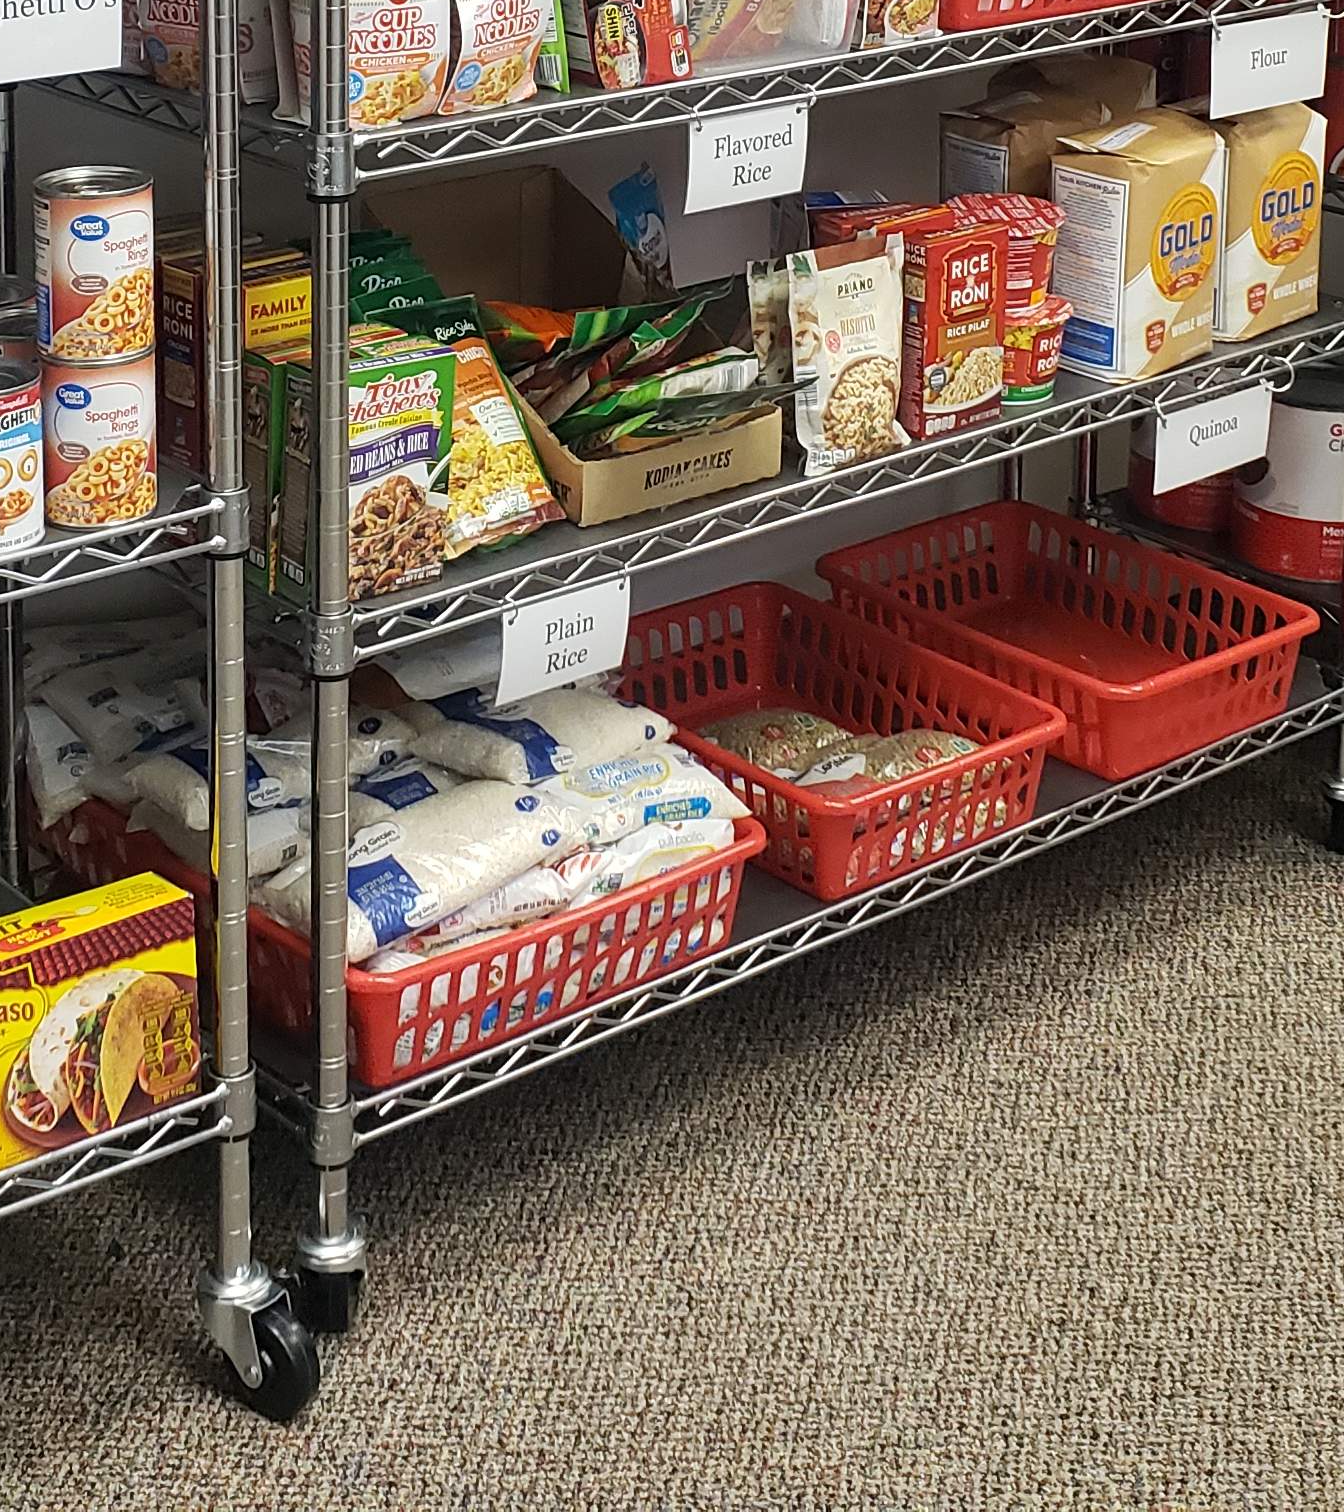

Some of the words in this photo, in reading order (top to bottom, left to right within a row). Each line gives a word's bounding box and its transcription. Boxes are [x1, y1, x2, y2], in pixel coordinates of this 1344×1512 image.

[360, 56, 406, 68] CHICKEN
[1251, 47, 1288, 70] Flour
[714, 125, 793, 159] Flavored
[732, 160, 772, 187] Rice
[74, 220, 104, 233] Great
[1159, 215, 1213, 259] GOLD
[127, 248, 149, 262] Rings
[951, 253, 989, 279] RICE
[838, 278, 873, 296] PRIANO
[950, 282, 989, 308] RONI
[968, 319, 990, 333] PILAF
[85, 405, 139, 423] Spaghetti
[111, 419, 139, 433] Rings
[1188, 414, 1238, 446] Quinoa
[544, 612, 595, 645] Plain
[544, 645, 588, 676] Rice
